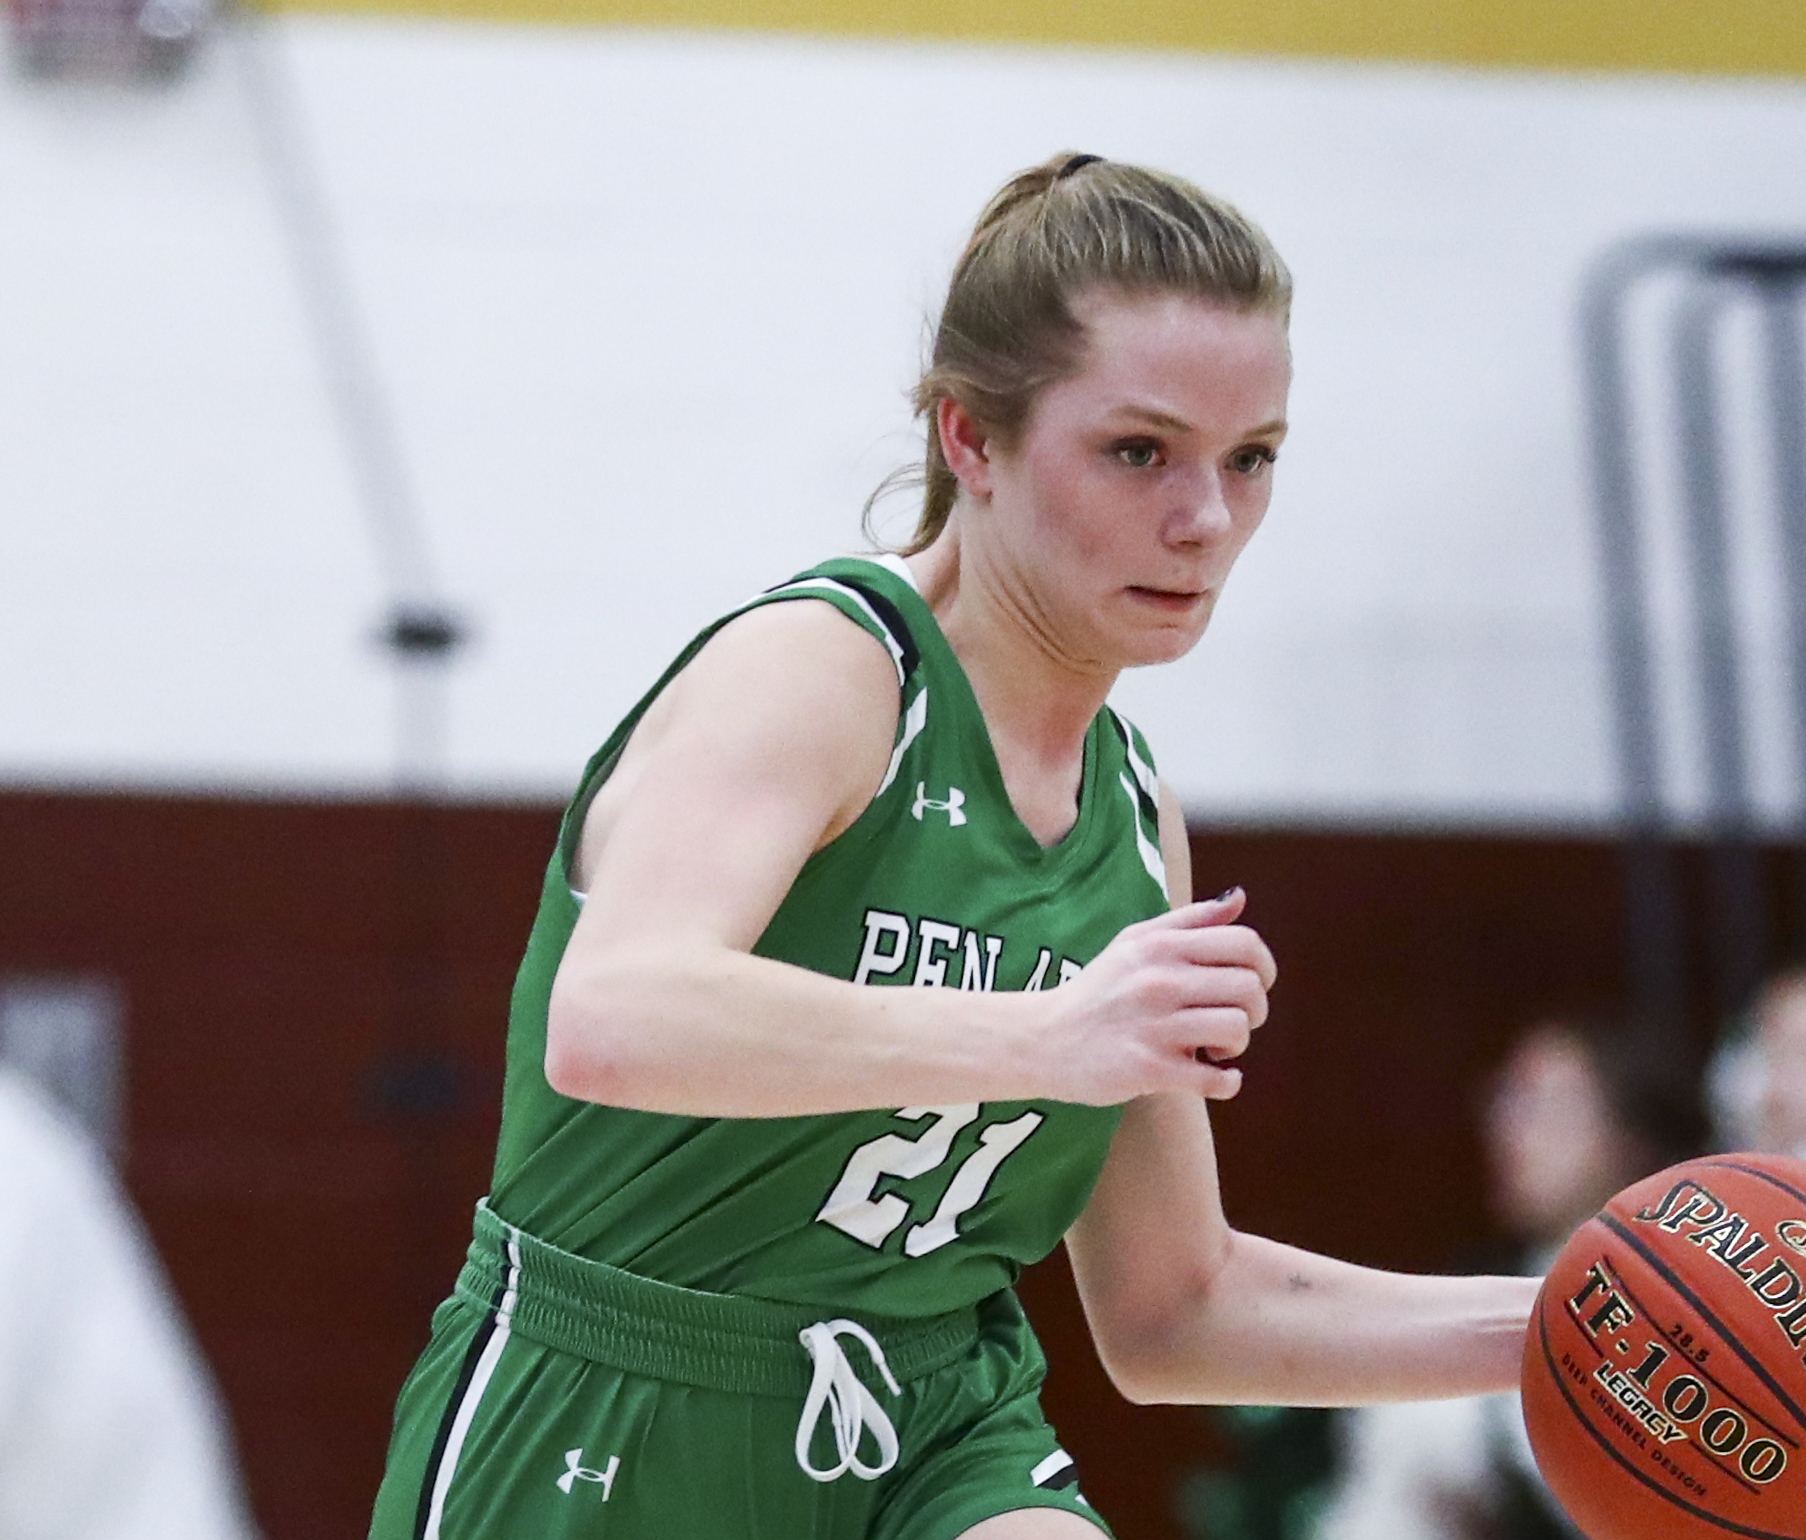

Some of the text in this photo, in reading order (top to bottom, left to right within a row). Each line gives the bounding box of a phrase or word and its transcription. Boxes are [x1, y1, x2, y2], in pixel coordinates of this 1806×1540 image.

[814, 1101, 1044, 1258] 21
[1570, 1261, 1788, 1484] TF-1000
[1669, 1322, 1710, 1363] 28.5
[1590, 1388, 1648, 1450] CHANNEL
[1651, 1449, 1708, 1496] DESIGN
[1593, 1359, 1689, 1445] LEGACY
